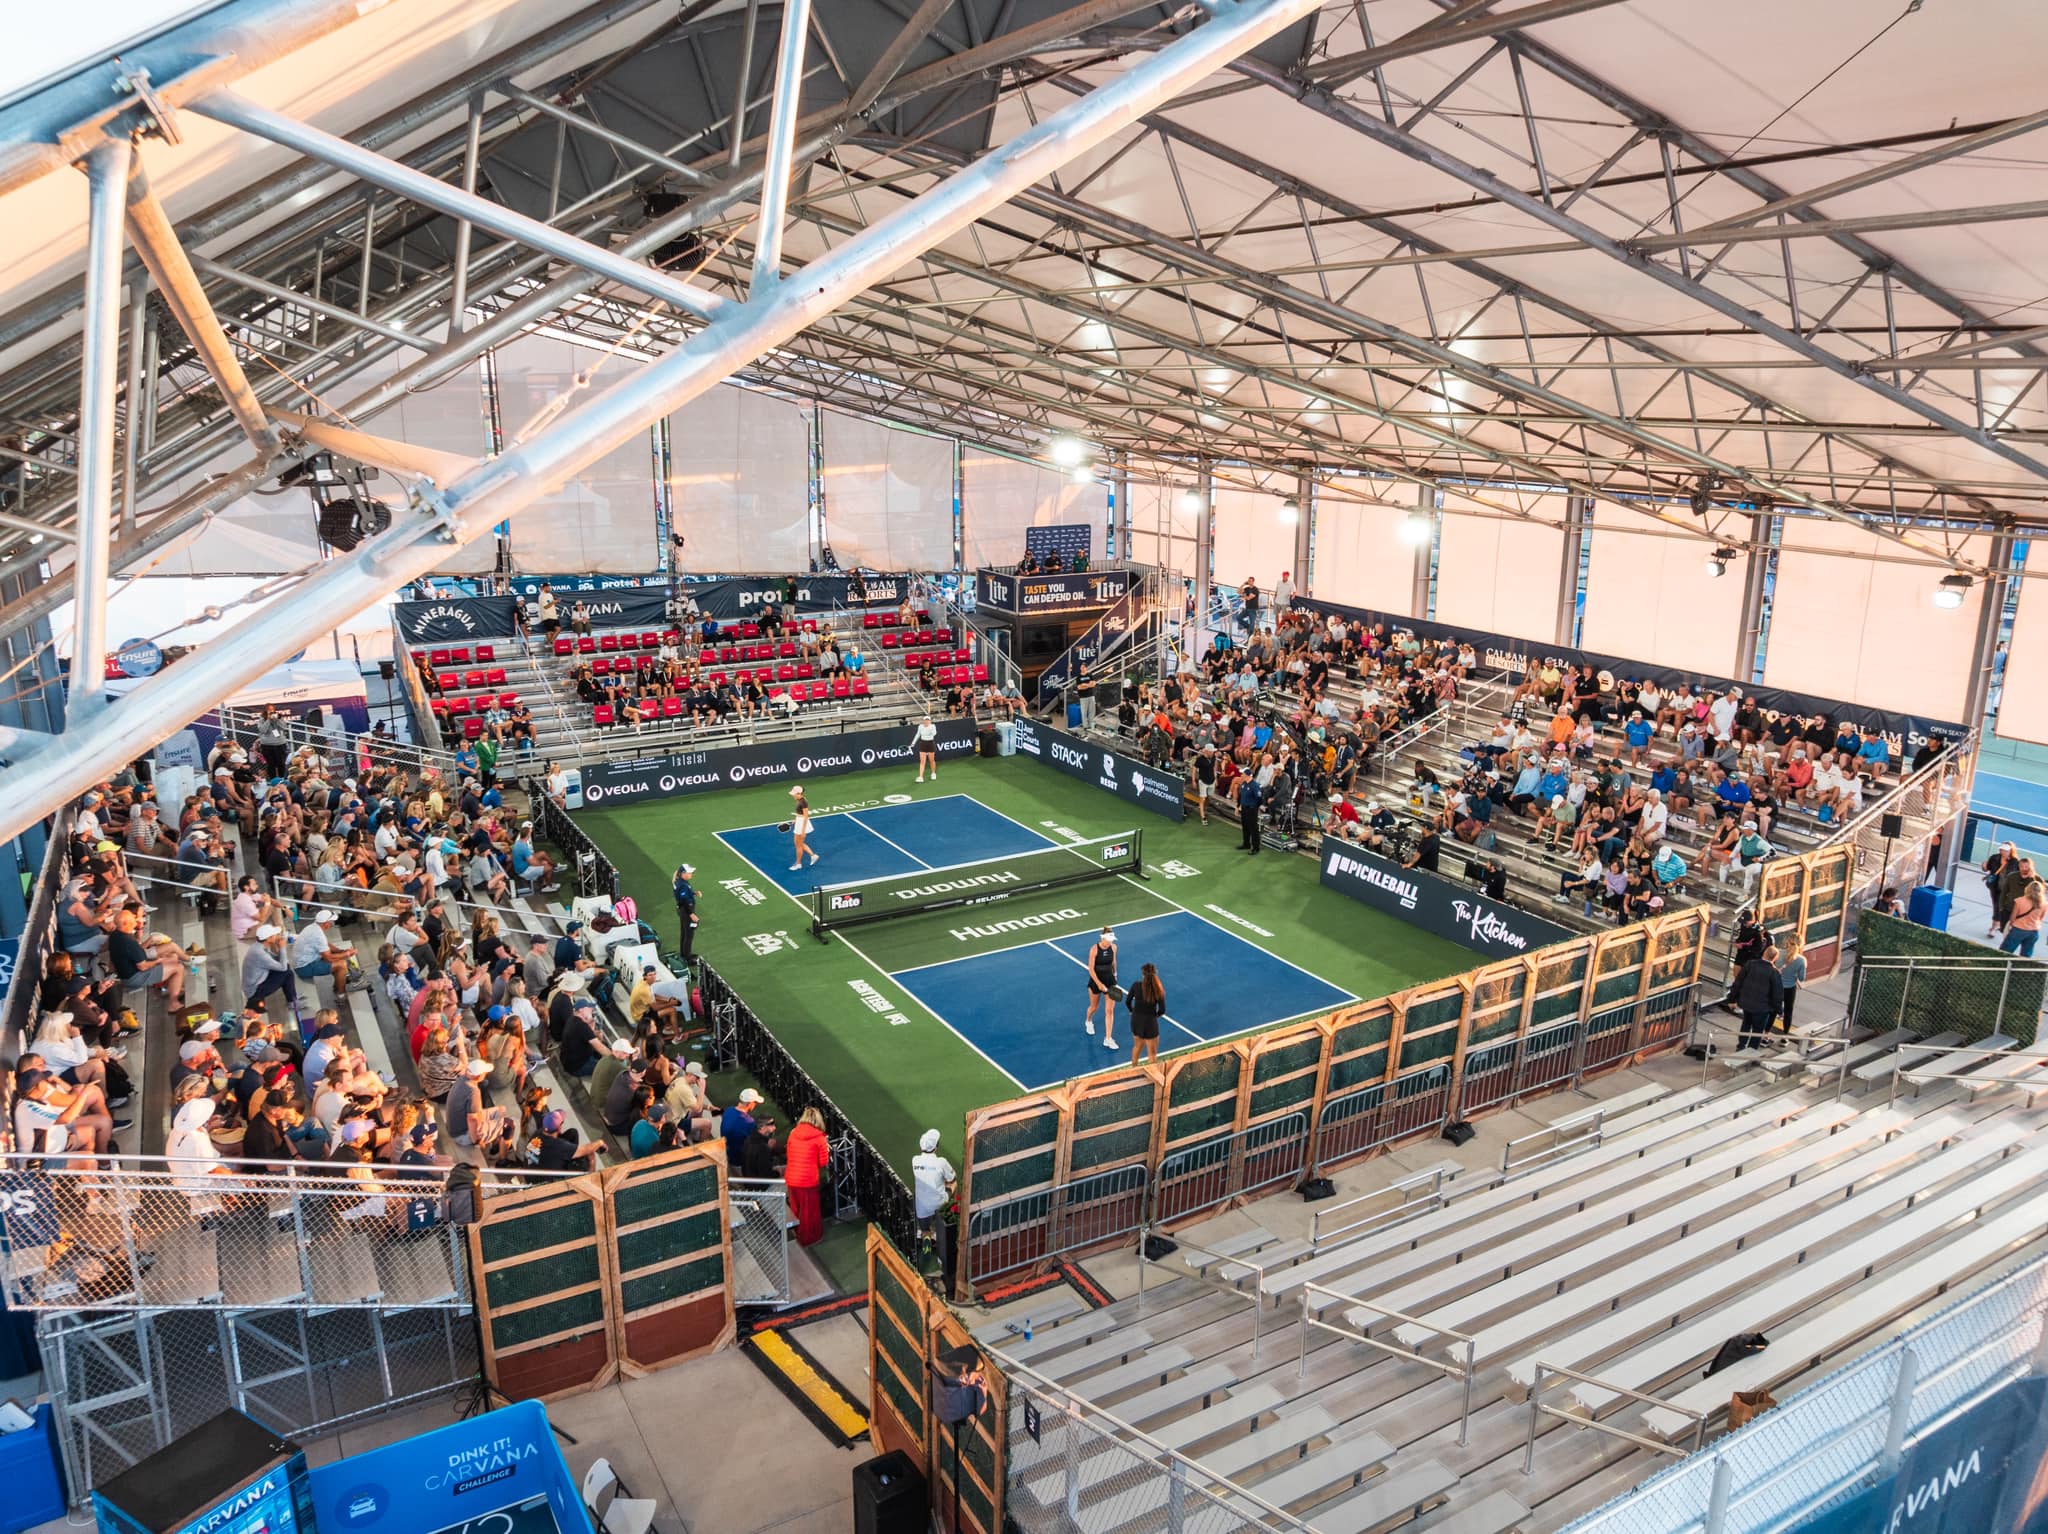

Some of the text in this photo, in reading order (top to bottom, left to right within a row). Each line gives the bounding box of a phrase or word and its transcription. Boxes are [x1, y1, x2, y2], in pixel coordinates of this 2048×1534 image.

[739, 588, 811, 608] protn
[988, 579, 1008, 604] Lite
[1024, 583, 1065, 595] TASTE YOU
[1024, 591, 1086, 605] CAN DEPEND ON.
[1095, 579, 1124, 602] Lite
[412, 606, 477, 635] MINERAGUA
[119, 649, 157, 662] Ensure
[1079, 647, 1096, 661] Lite
[1930, 726, 1947, 735] OPEN
[876, 748, 914, 760] VEOLIA
[936, 739, 972, 752] VEOLIA
[812, 755, 852, 768] VEOLIA
[1051, 743, 1084, 769] STACK
[676, 772, 720, 787] VEOLIA
[747, 763, 788, 778] VEOLIA
[604, 782, 649, 796] VEOLIA
[1100, 776, 1118, 791] RESET
[1143, 777, 1169, 792] palmetto
[1144, 785, 1179, 804] windscreens
[1348, 862, 1418, 901] PICKLEBALL
[949, 908, 1088, 941] Humana.
[1452, 900, 1527, 949] The Kitchen
[449, 1436, 511, 1467] DINK IT!
[424, 1442, 539, 1491] CARVANA
[458, 1467, 512, 1492] CHALLENGE
[1884, 1450, 1982, 1534] RVANA
[188, 1480, 276, 1534] ARVANA
